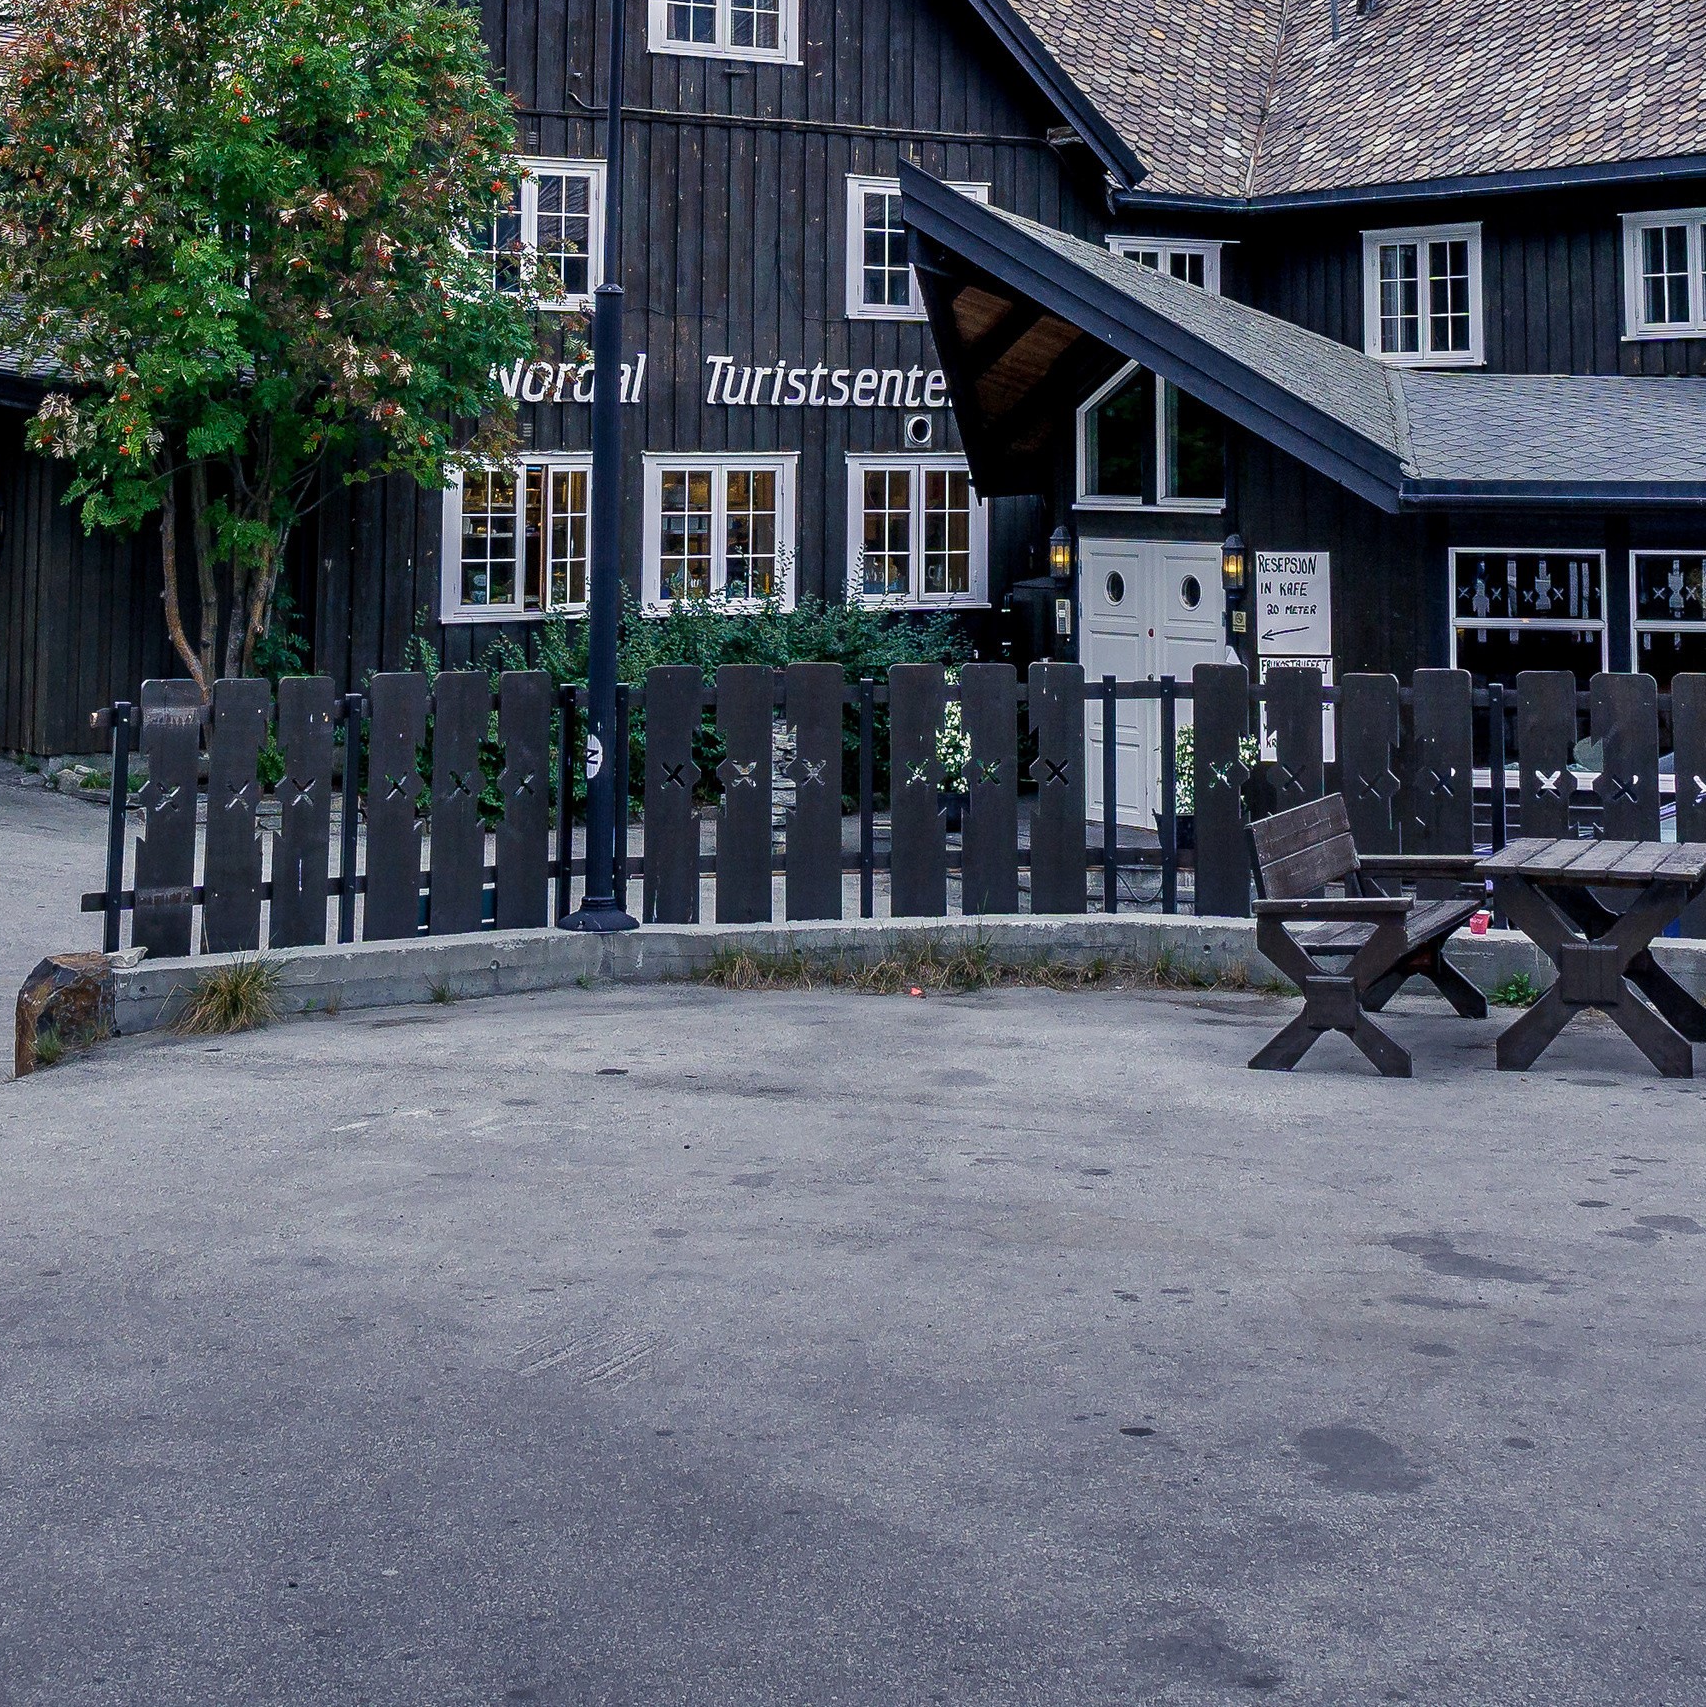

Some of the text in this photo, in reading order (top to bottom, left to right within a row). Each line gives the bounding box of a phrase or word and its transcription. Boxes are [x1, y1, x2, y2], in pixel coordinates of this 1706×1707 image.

[705, 354, 953, 408] Turistsente
[1257, 554, 1318, 575] RESEPSJON
[1260, 581, 1309, 597] IN KAFE
[1266, 603, 1318, 616] 20 METER
